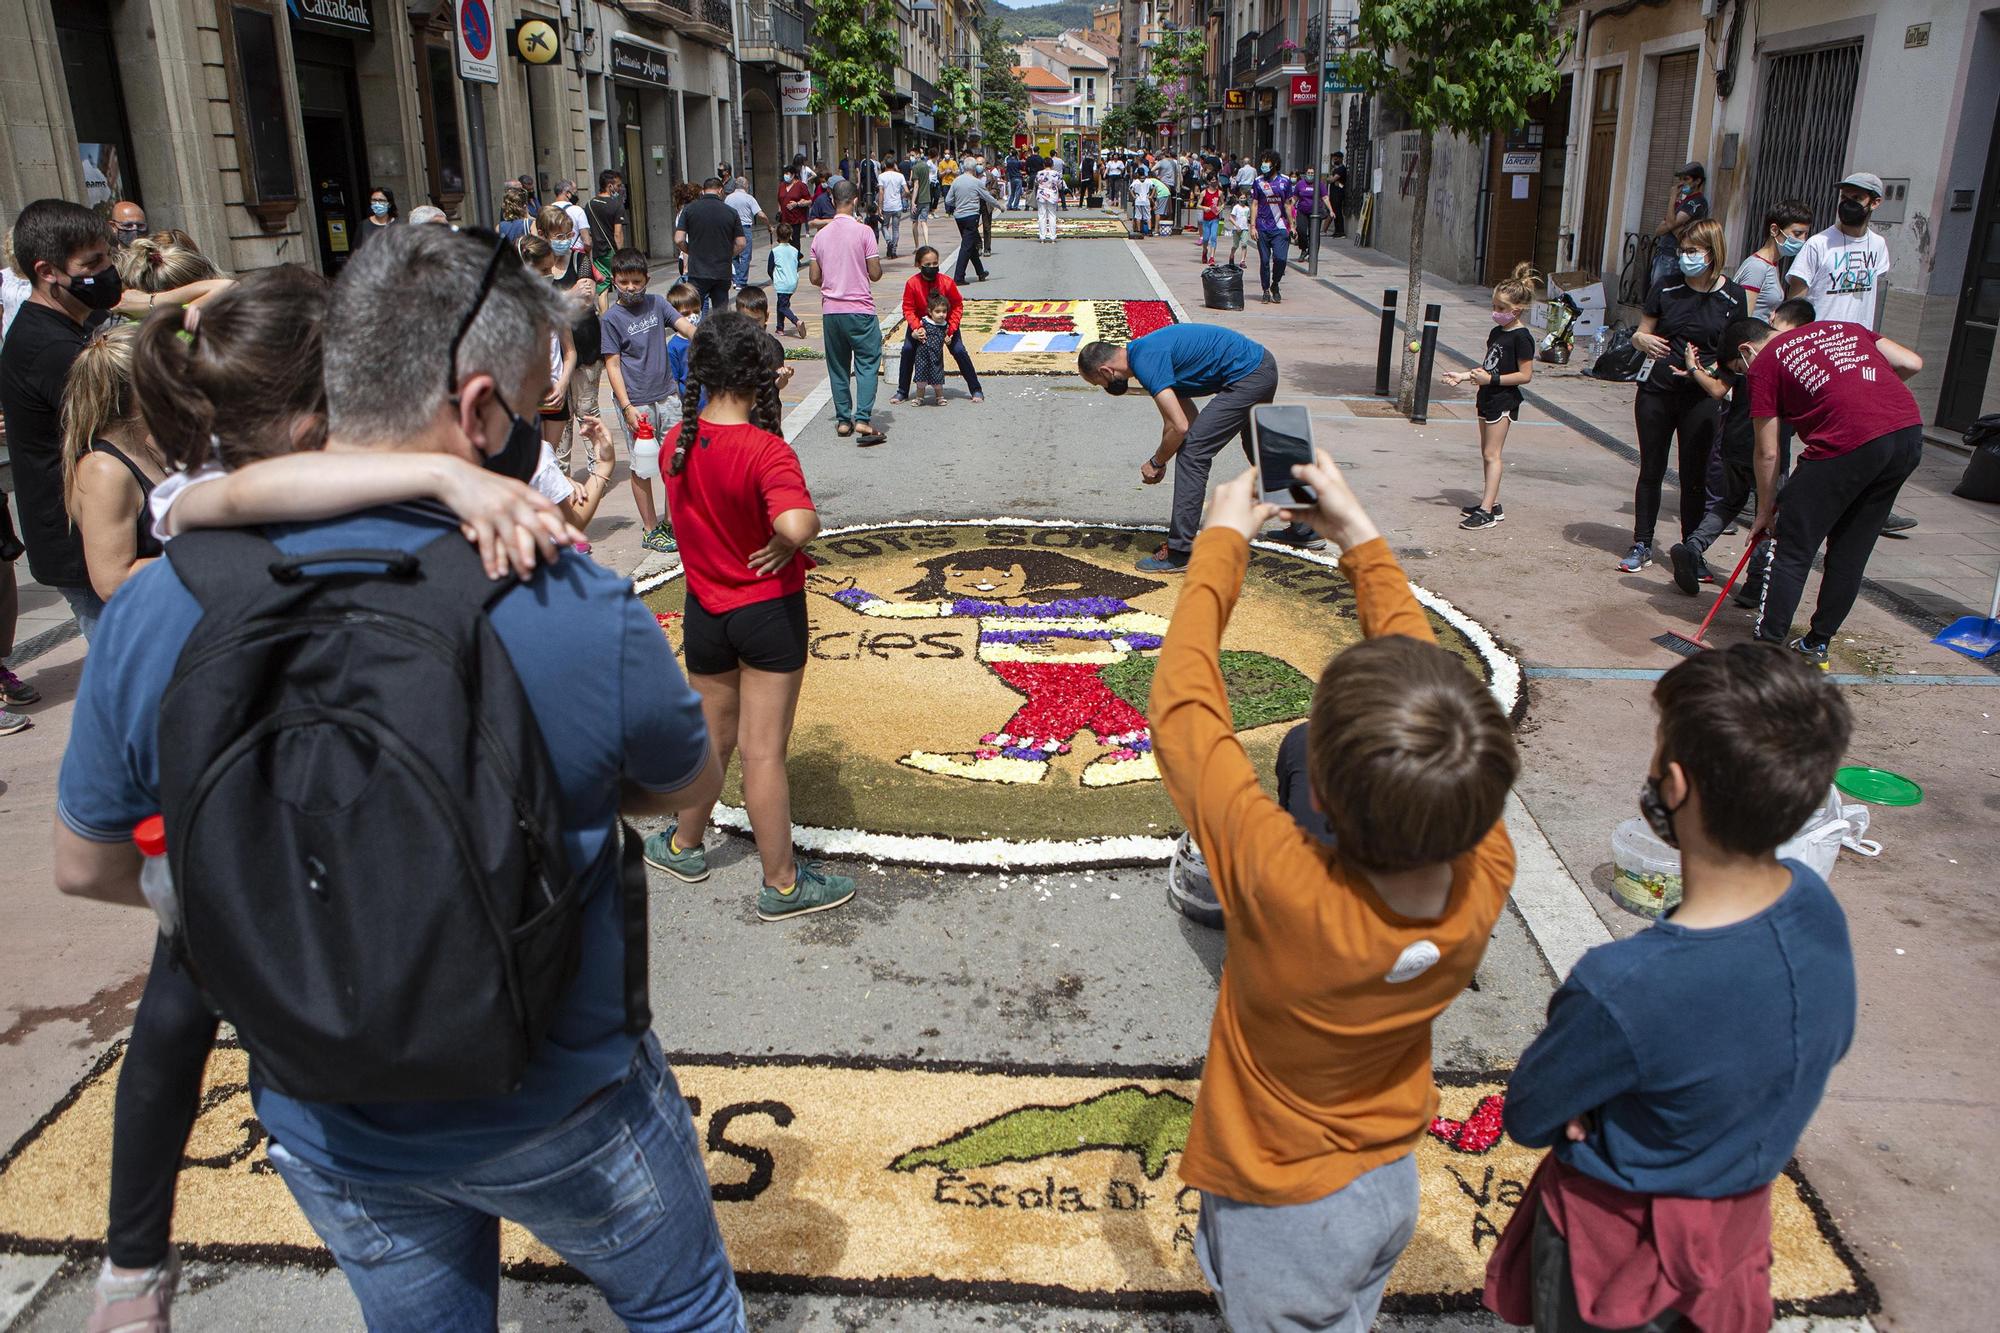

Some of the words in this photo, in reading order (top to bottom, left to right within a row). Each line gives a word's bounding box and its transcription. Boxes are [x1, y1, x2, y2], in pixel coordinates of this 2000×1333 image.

[302, 0, 370, 24] CaixaBank
[1835, 251, 1877, 270] NEW
[1829, 269, 1877, 290] YORK
[1775, 329, 1827, 359] PASSADA
[1788, 348, 1816, 372] ROBERTO
[1834, 354, 1869, 367] MERCADER
[1839, 363, 1857, 373] TURA
[1799, 364, 1819, 383] COSTA
[934, 1172, 1098, 1213] Escola
